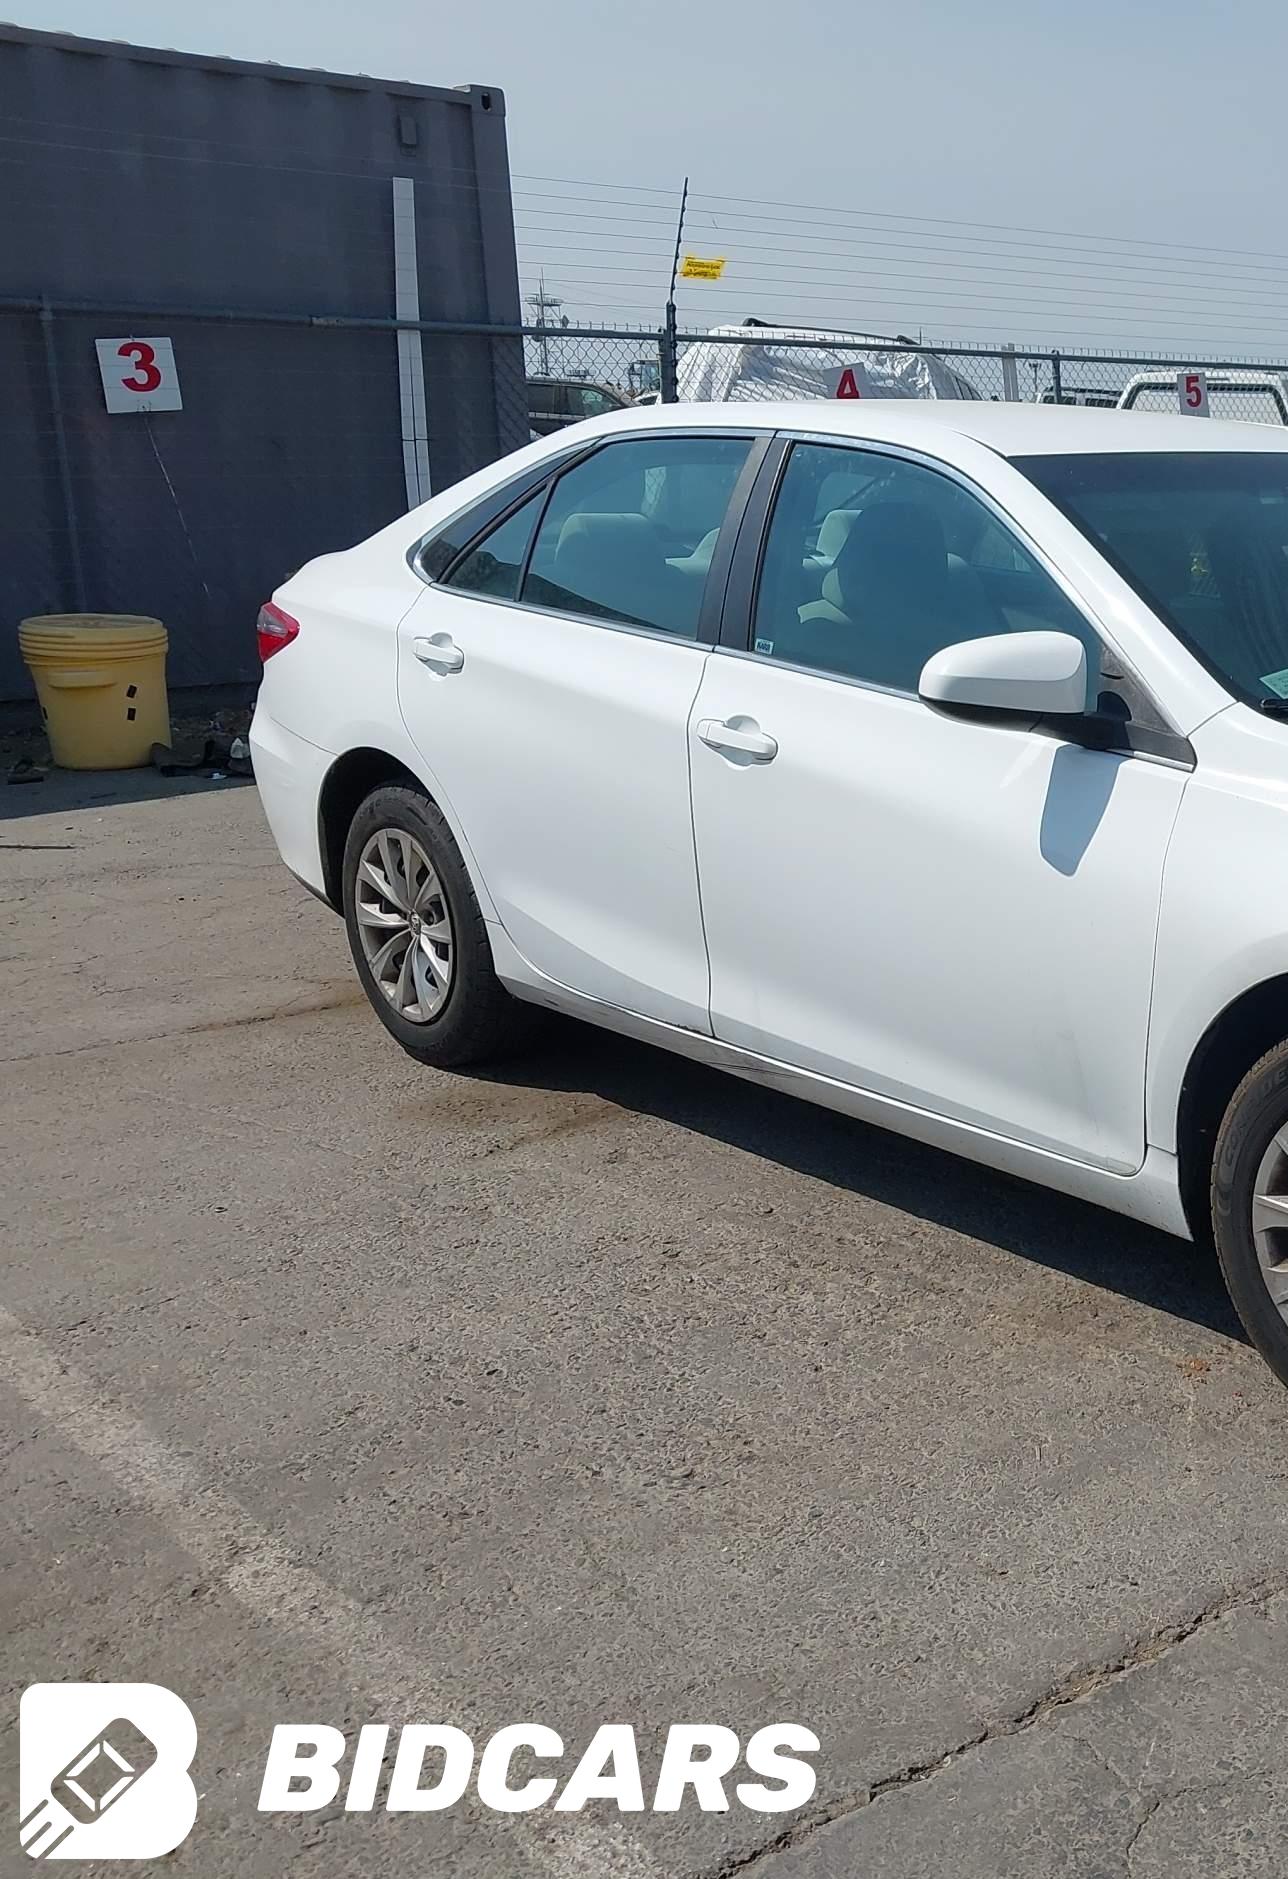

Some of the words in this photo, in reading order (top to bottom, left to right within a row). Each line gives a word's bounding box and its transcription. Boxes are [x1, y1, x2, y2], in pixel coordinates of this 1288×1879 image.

[117, 341, 162, 393] 3
[836, 368, 860, 399] 4
[1185, 375, 1202, 408] 5
